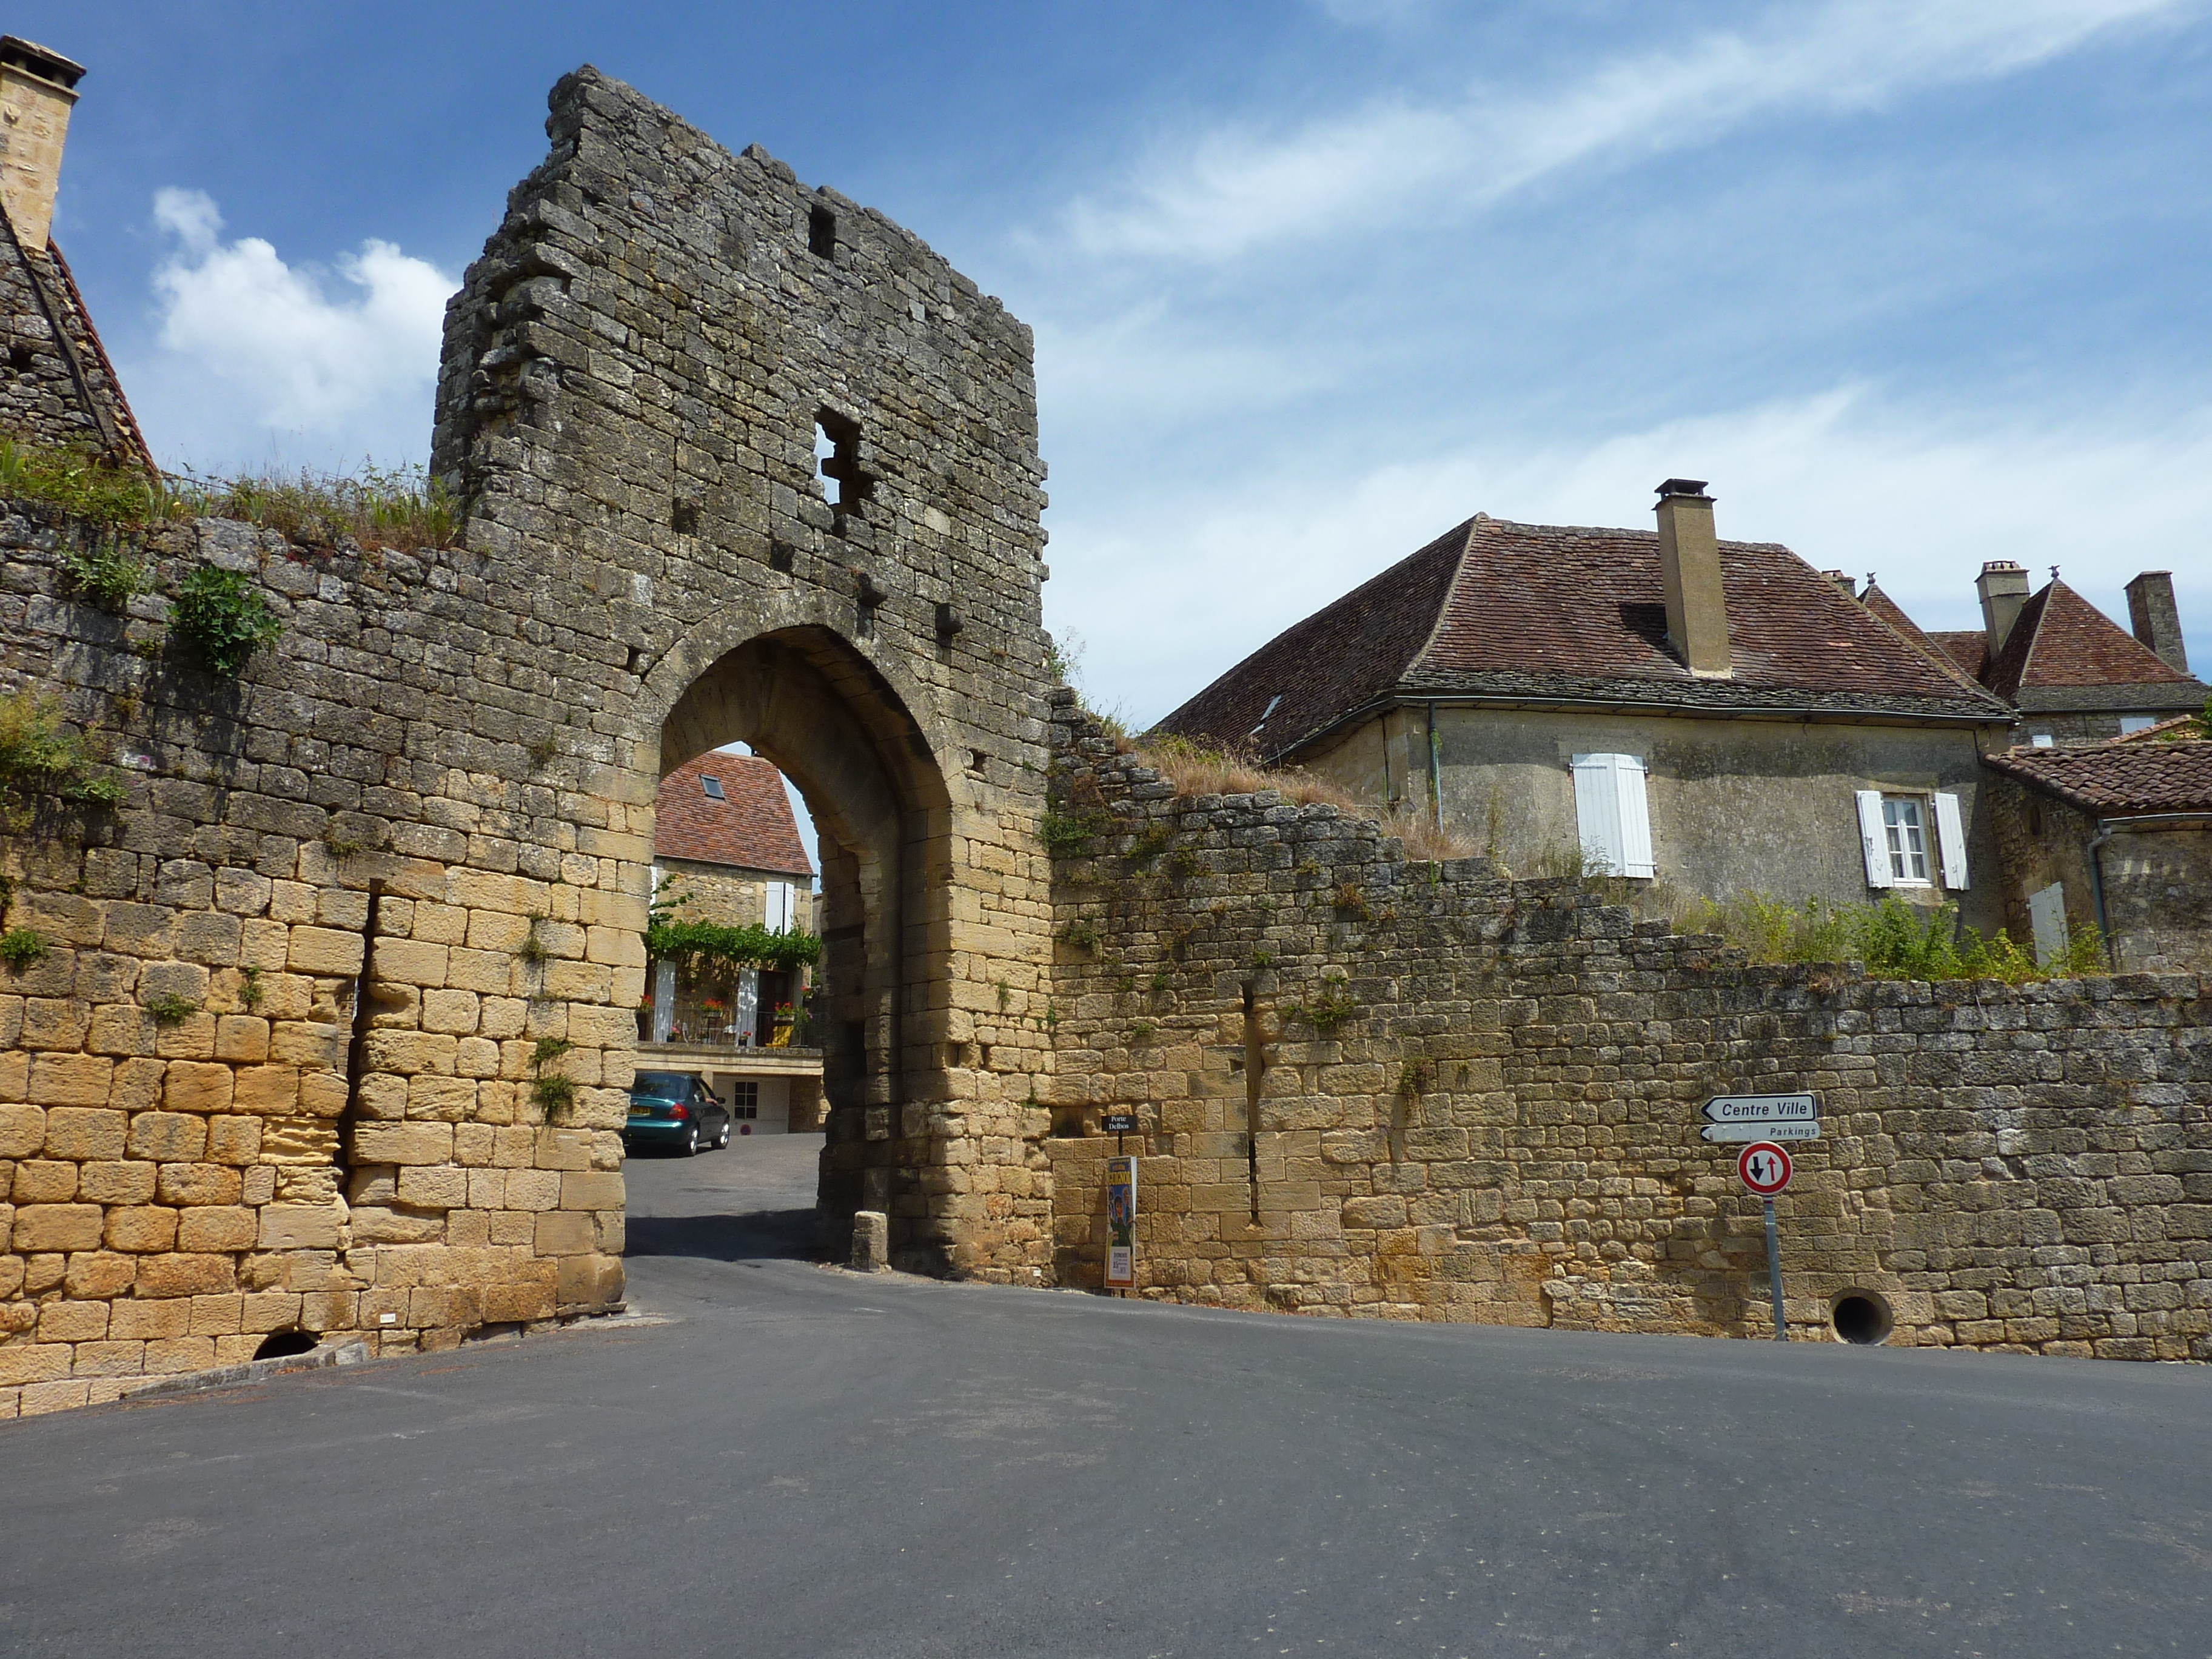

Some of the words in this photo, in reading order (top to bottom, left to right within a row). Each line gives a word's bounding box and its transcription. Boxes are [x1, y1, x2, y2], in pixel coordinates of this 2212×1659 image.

[1722, 1104, 1769, 1116] Centre
[1777, 1102, 1807, 1114] Ville
[1770, 1127, 1816, 1138] Parkings
[1108, 1171, 1131, 1185] GUIGNOL
